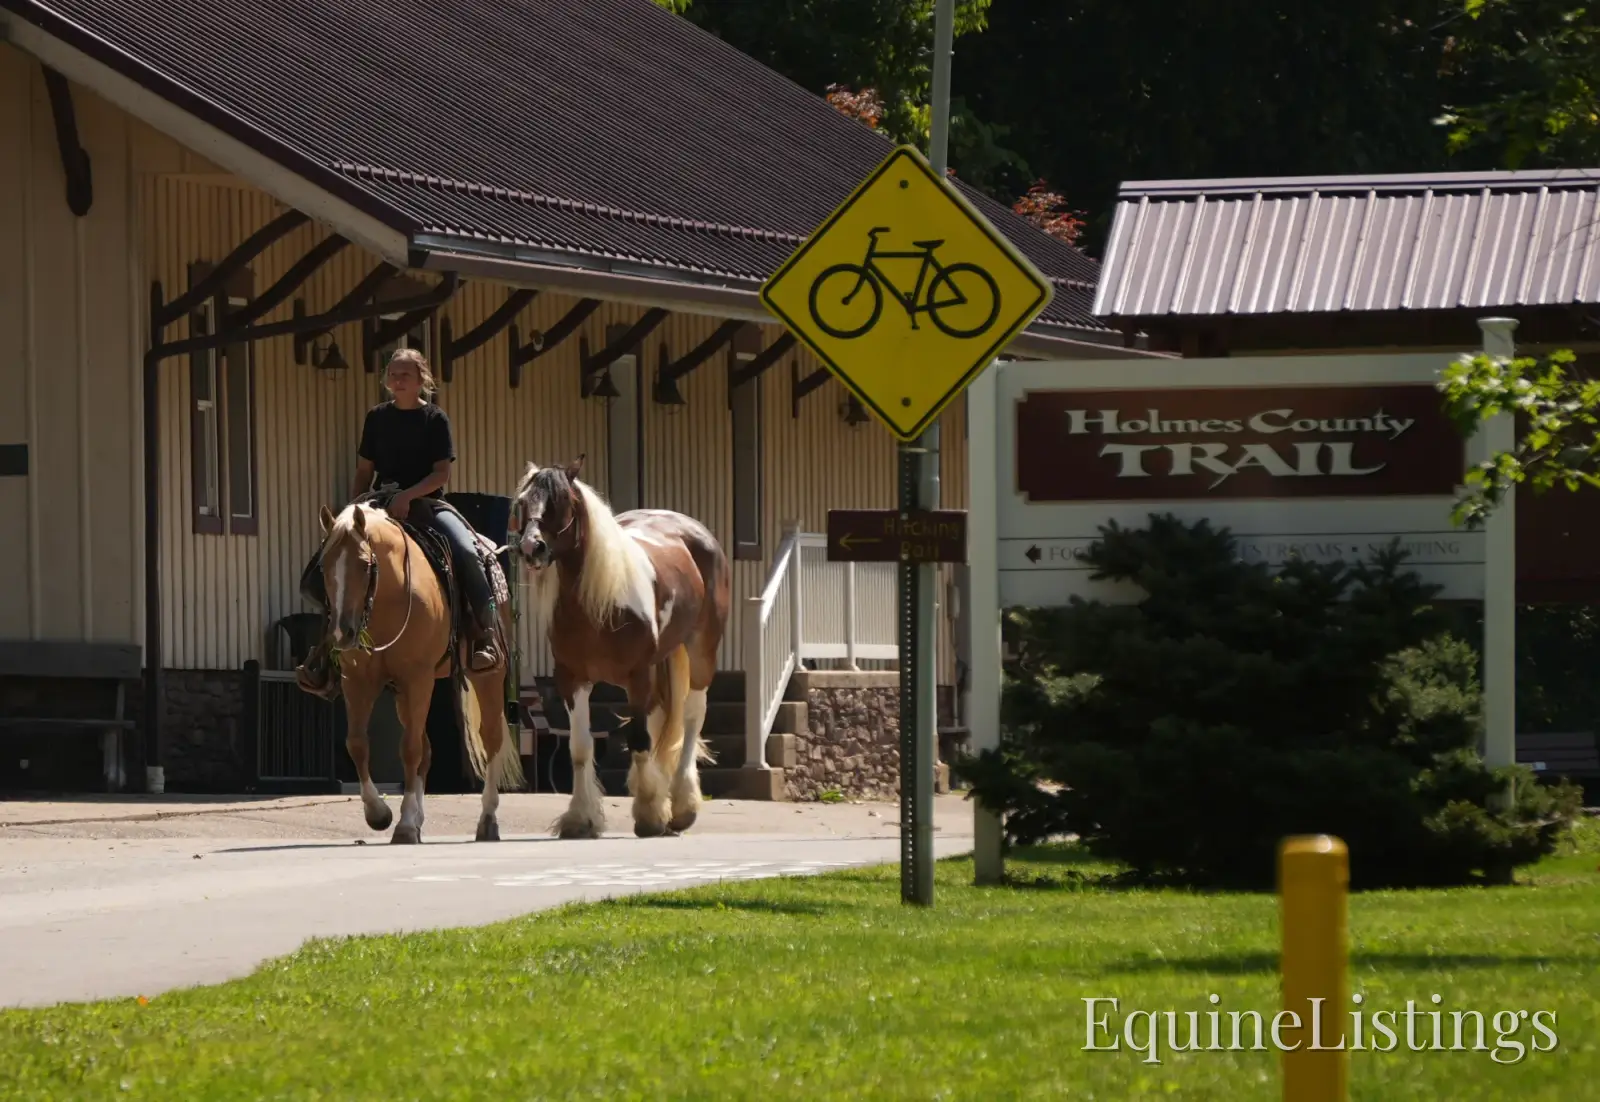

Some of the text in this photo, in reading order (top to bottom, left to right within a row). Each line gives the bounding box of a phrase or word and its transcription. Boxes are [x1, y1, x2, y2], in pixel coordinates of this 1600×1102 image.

[1064, 406, 1416, 441] Holmes County
[1098, 441, 1387, 491] TRAIL
